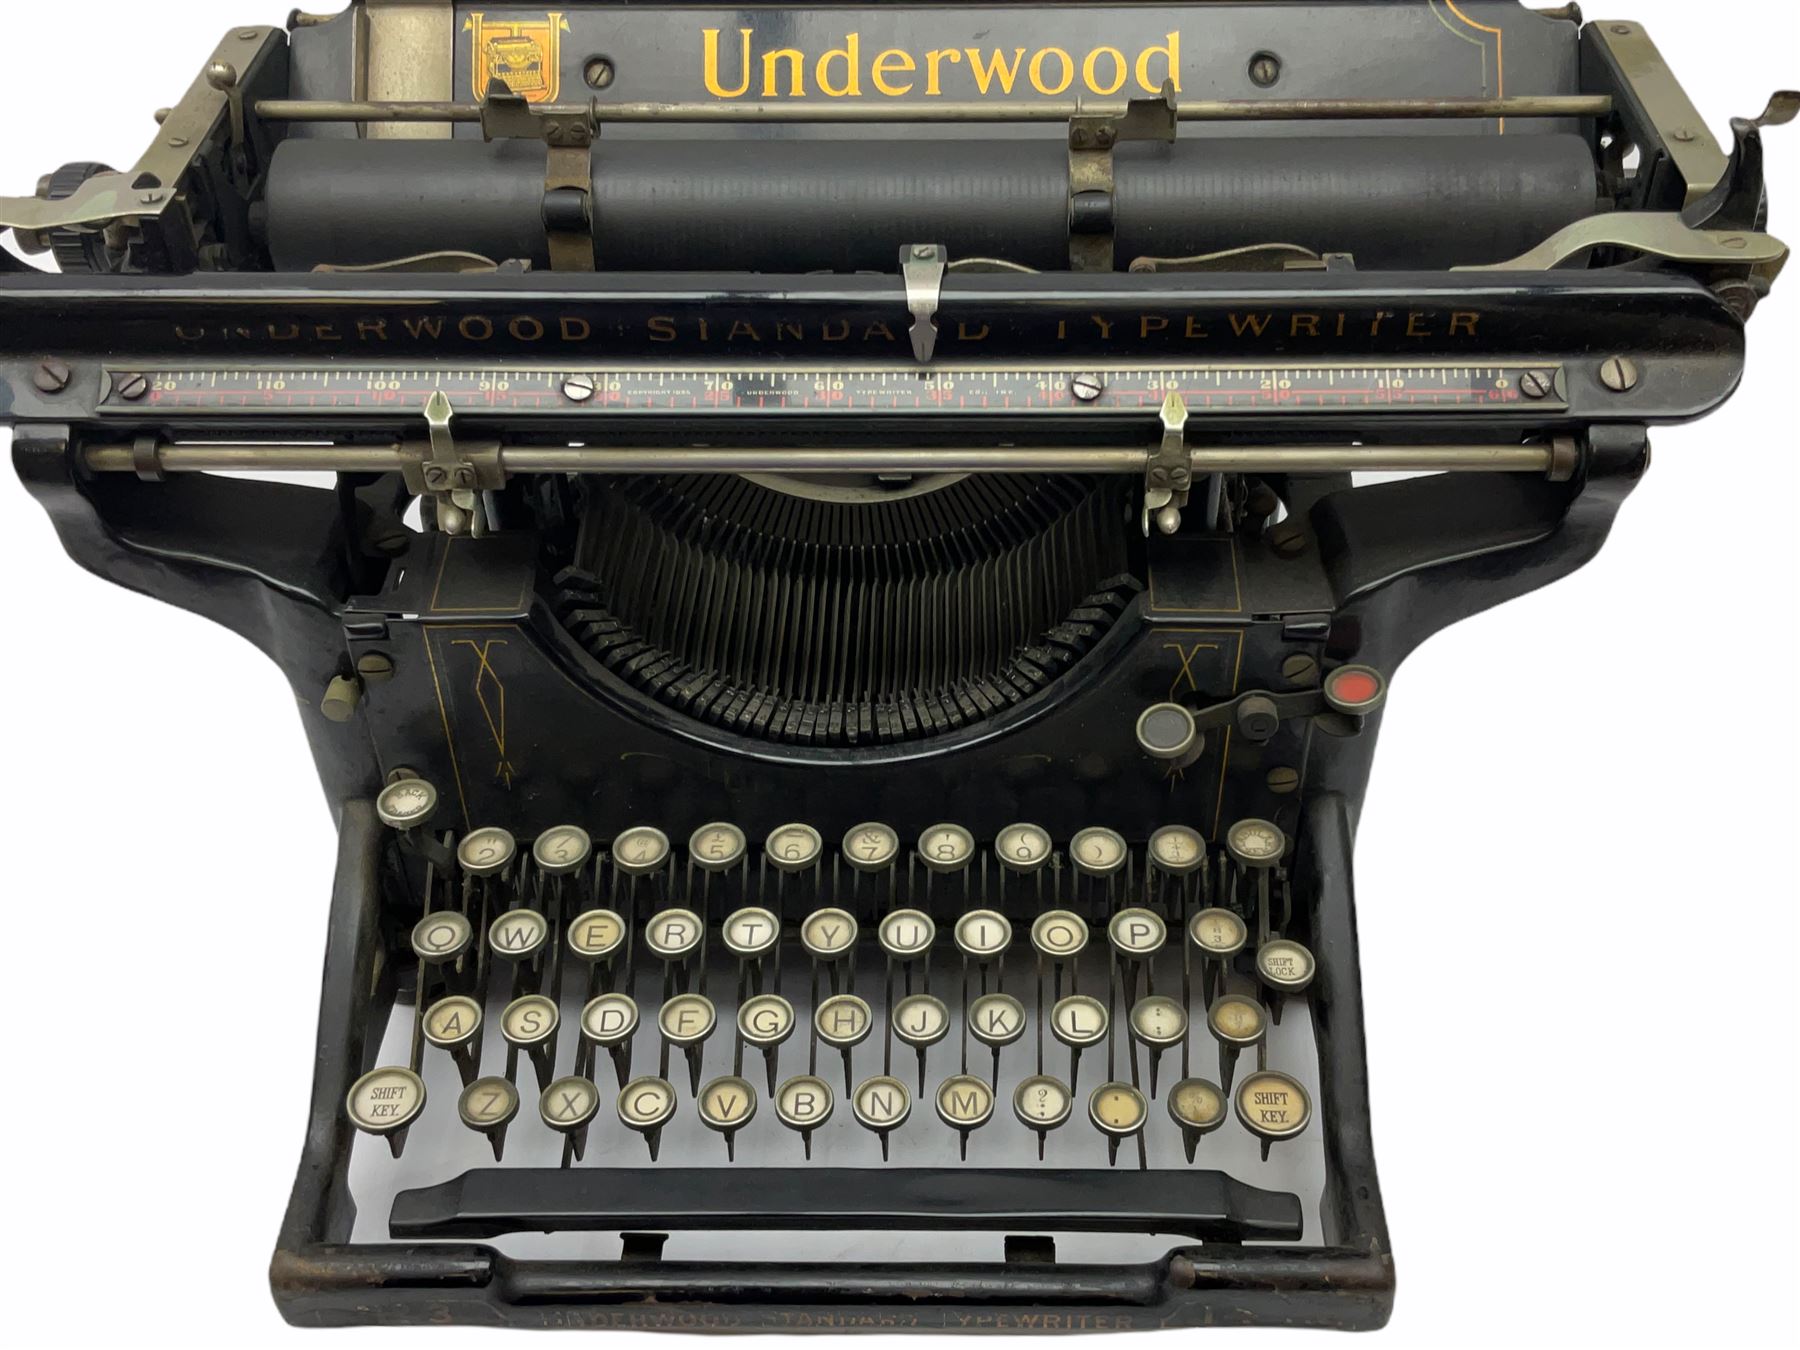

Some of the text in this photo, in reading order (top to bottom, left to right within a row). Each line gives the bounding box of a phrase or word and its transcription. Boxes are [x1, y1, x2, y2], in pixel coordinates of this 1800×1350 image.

[701, 27, 1183, 98] Underwood
[647, 315, 989, 342] STANDAD
[256, 381, 285, 390] 110
[367, 381, 401, 391] 100
[479, 381, 510, 392] 90
[704, 381, 733, 391] 70
[814, 381, 844, 391] 60
[924, 381, 954, 391] 50
[1035, 381, 1065, 391] 40
[1147, 380, 1178, 390] 30
[1260, 379, 1291, 390] 20
[1378, 379, 1404, 389] 10
[1495, 379, 1508, 389] 0
[861, 831, 881, 845] &
[478, 848, 496, 861] 2
[555, 849, 569, 861] 3
[632, 850, 647, 862] 4
[710, 844, 724, 857] 5
[784, 843, 801, 860] 6
[861, 846, 880, 861] 7
[936, 844, 955, 860] 8
[1015, 846, 1031, 860] 9
[427, 925, 455, 951] Q
[503, 927, 534, 948] W
[585, 925, 608, 948] E
[664, 924, 685, 945] R
[741, 924, 763, 945] T
[820, 926, 840, 947] Y
[896, 926, 918, 948] U
[980, 926, 986, 947] I
[1047, 926, 1074, 947] O
[1130, 923, 1150, 945] P
[1267, 957, 1294, 967] SHIFT
[1269, 966, 1296, 977] LOCK
[441, 1011, 462, 1035] A
[519, 1010, 542, 1034] S
[600, 1010, 625, 1033] D
[677, 1010, 699, 1033] F
[752, 1010, 779, 1034] G
[833, 1010, 856, 1033] H
[910, 1010, 927, 1033] J
[989, 1009, 1010, 1033] K
[1071, 1010, 1094, 1033] L
[370, 1086, 407, 1100] SHIFT
[951, 1091, 978, 1116] M
[1254, 1092, 1288, 1105] SHIFT
[370, 1103, 400, 1117] KEY.
[478, 1092, 498, 1116] Z
[558, 1091, 582, 1117] X
[633, 1091, 660, 1117] C
[716, 1095, 737, 1118] V
[793, 1092, 815, 1116] B
[870, 1091, 893, 1117] N
[1260, 1109, 1289, 1124] KEY.
